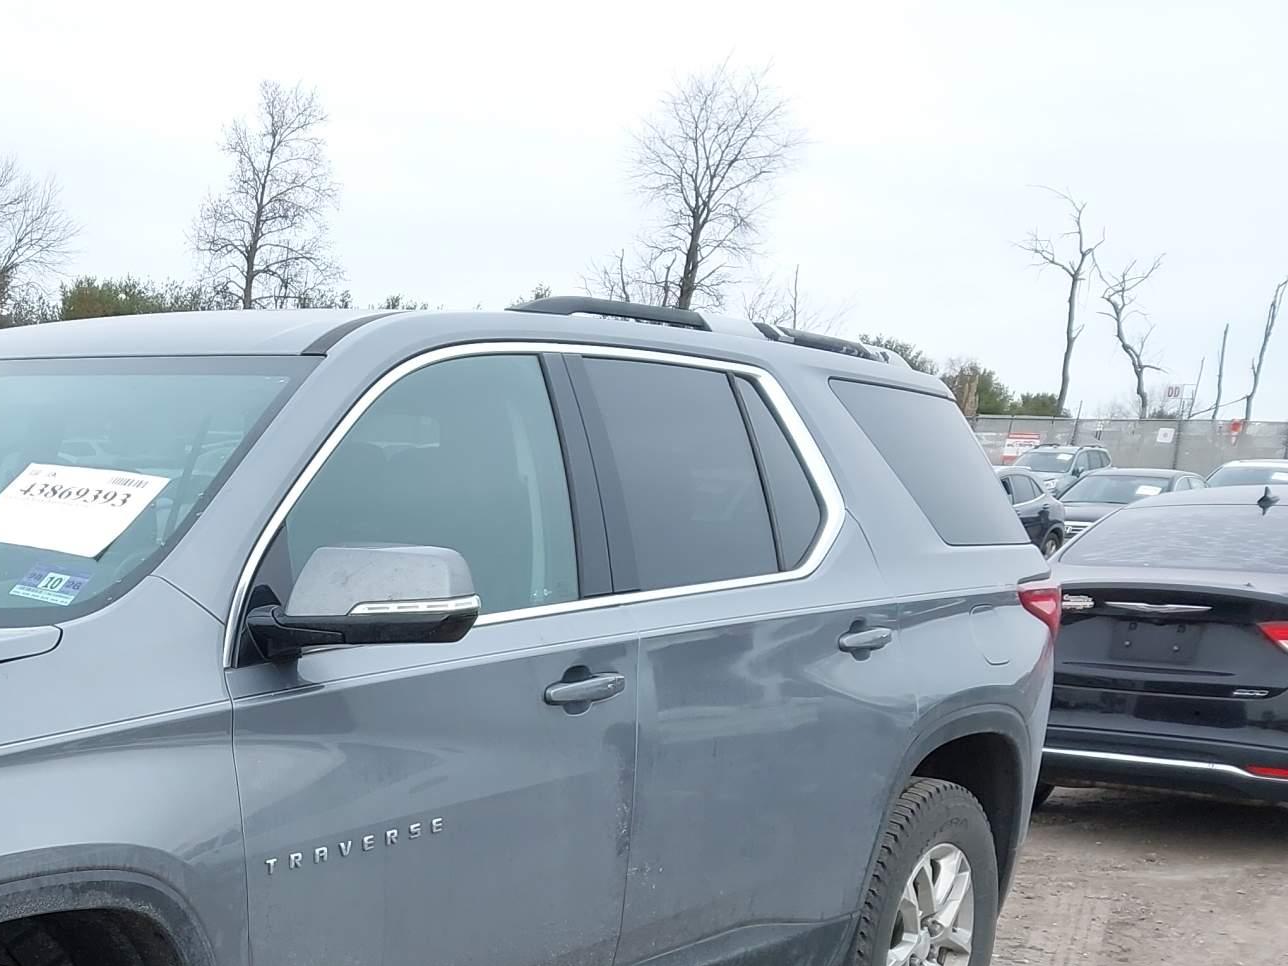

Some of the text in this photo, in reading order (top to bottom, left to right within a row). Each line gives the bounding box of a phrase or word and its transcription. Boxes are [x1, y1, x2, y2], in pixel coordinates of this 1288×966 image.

[19, 482, 132, 507] 43869393
[43, 576, 64, 590] 10
[265, 817, 444, 875] TRAVERSE
